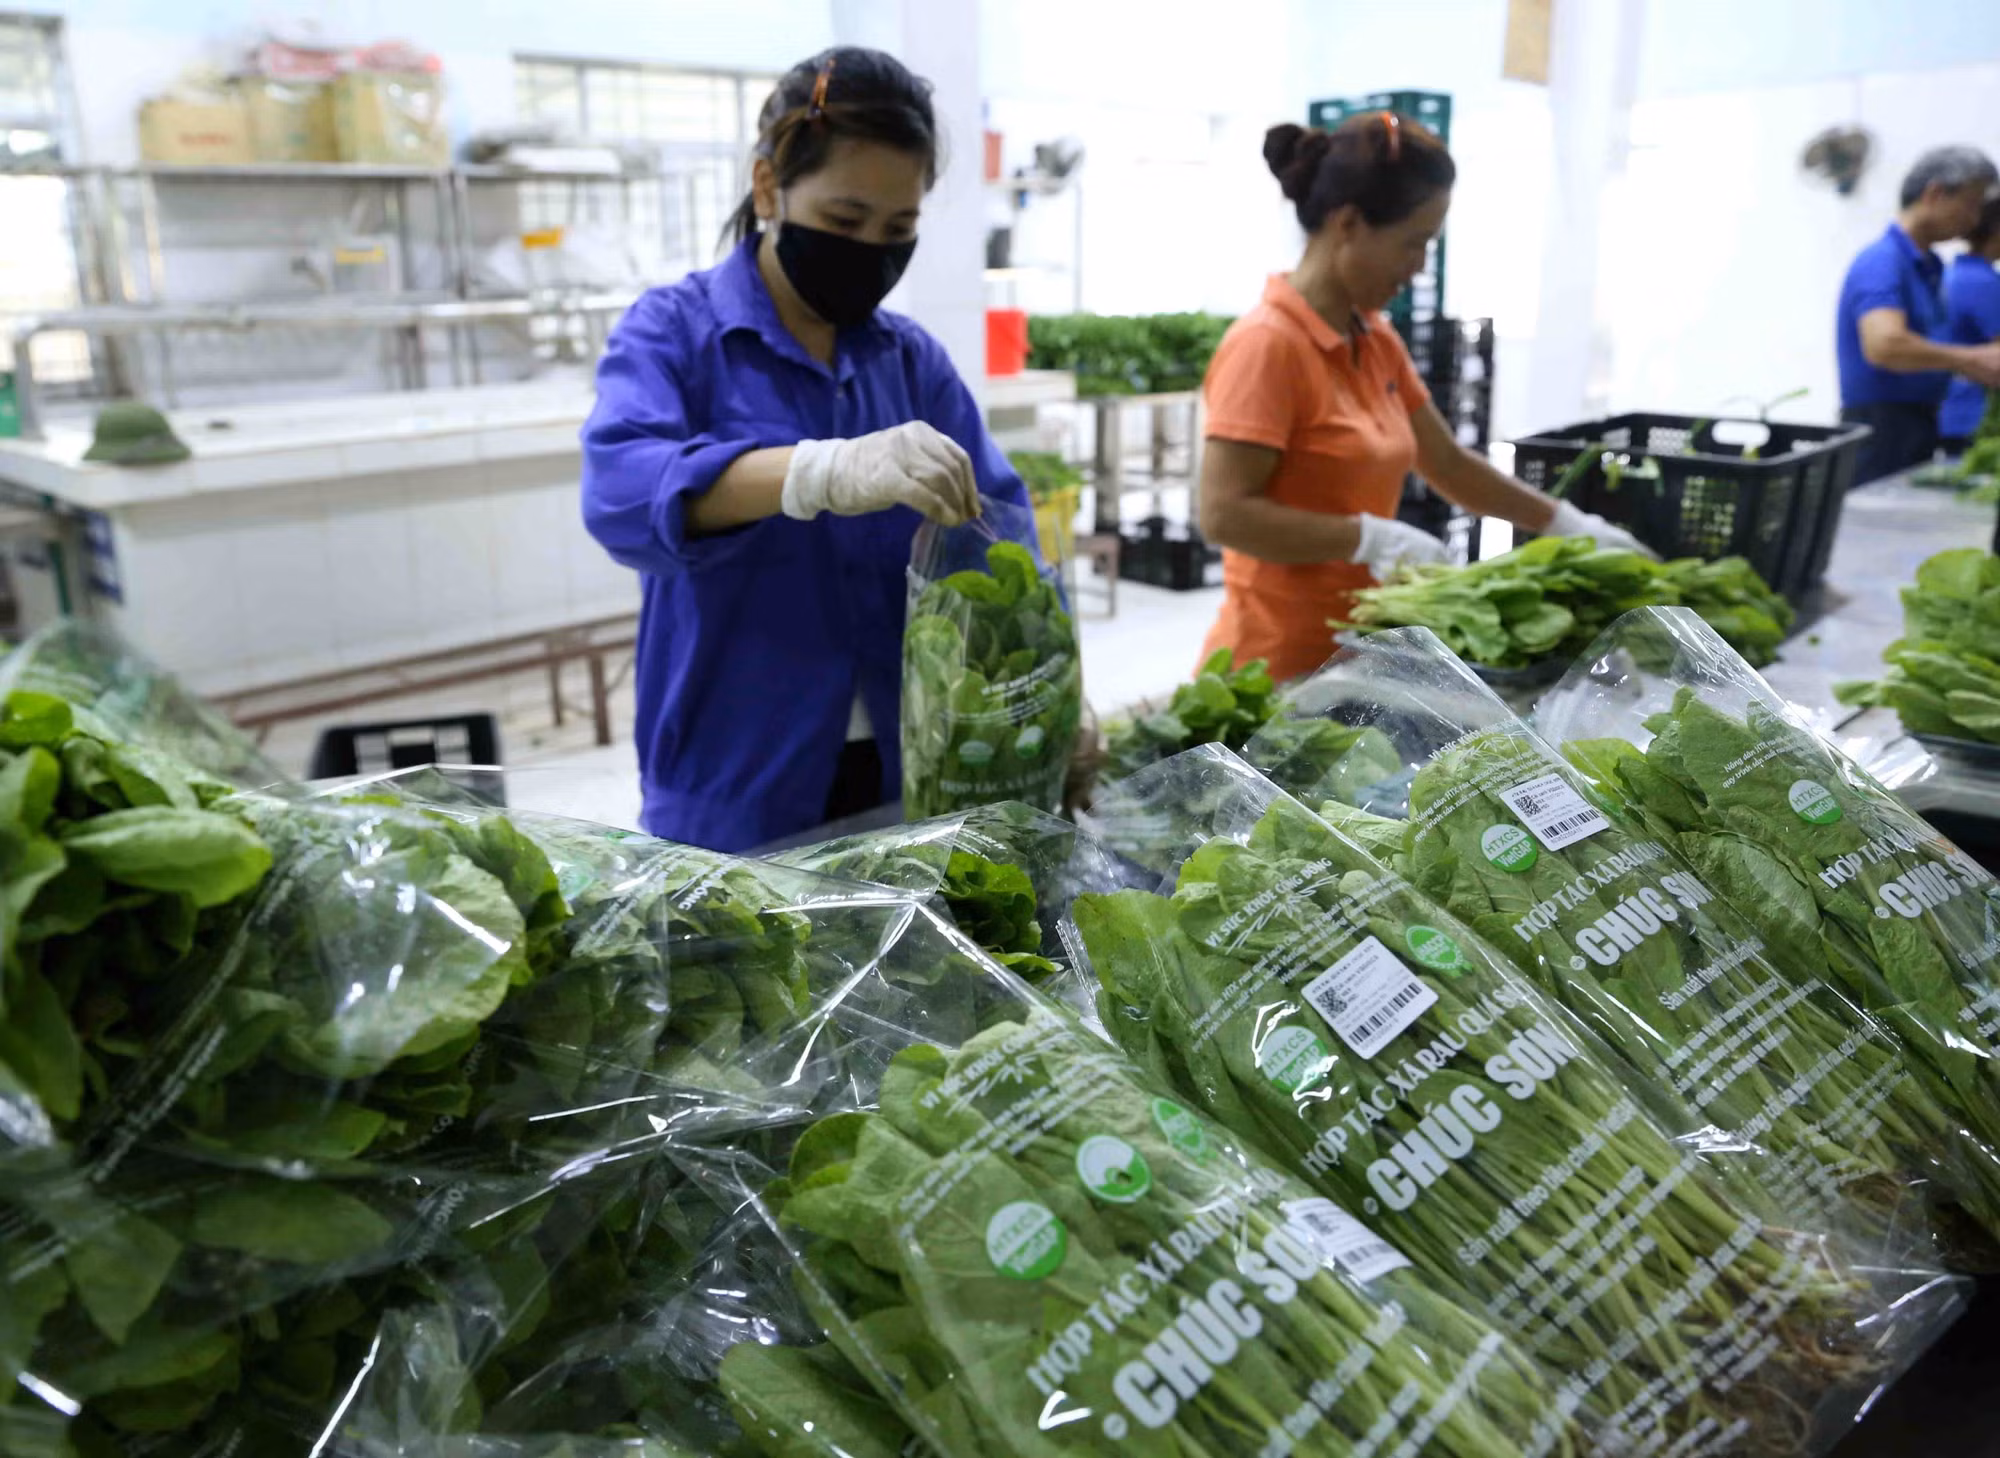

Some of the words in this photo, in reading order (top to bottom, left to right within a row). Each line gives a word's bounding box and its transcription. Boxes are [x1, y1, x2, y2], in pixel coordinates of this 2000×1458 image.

[1723, 755, 1744, 773] Nông
[1740, 746, 1756, 761] dân
[1443, 784, 1459, 801] HTX
[1792, 784, 1823, 808] HTXCS
[1485, 826, 1519, 854] HTXCS
[1497, 838, 1533, 869] VietGAP
[1817, 847, 1866, 892] HỢP
[1511, 895, 1562, 944] HỢP
[1551, 870, 1596, 913] TÁC
[1585, 855, 1618, 890] XÃ
[1608, 843, 1644, 876] RAU
[1574, 878, 1677, 970] CHÚC
[1263, 1027, 1308, 1071] HTXCS
[1340, 1080, 1396, 1139] TÁC
[1383, 1052, 1428, 1102] XÃ
[1414, 1021, 1467, 1075] RAU
[1362, 1075, 1499, 1212] CHÚC
[1482, 1009, 1576, 1108] SƠN
[1110, 1273, 1260, 1430] CHÚC
